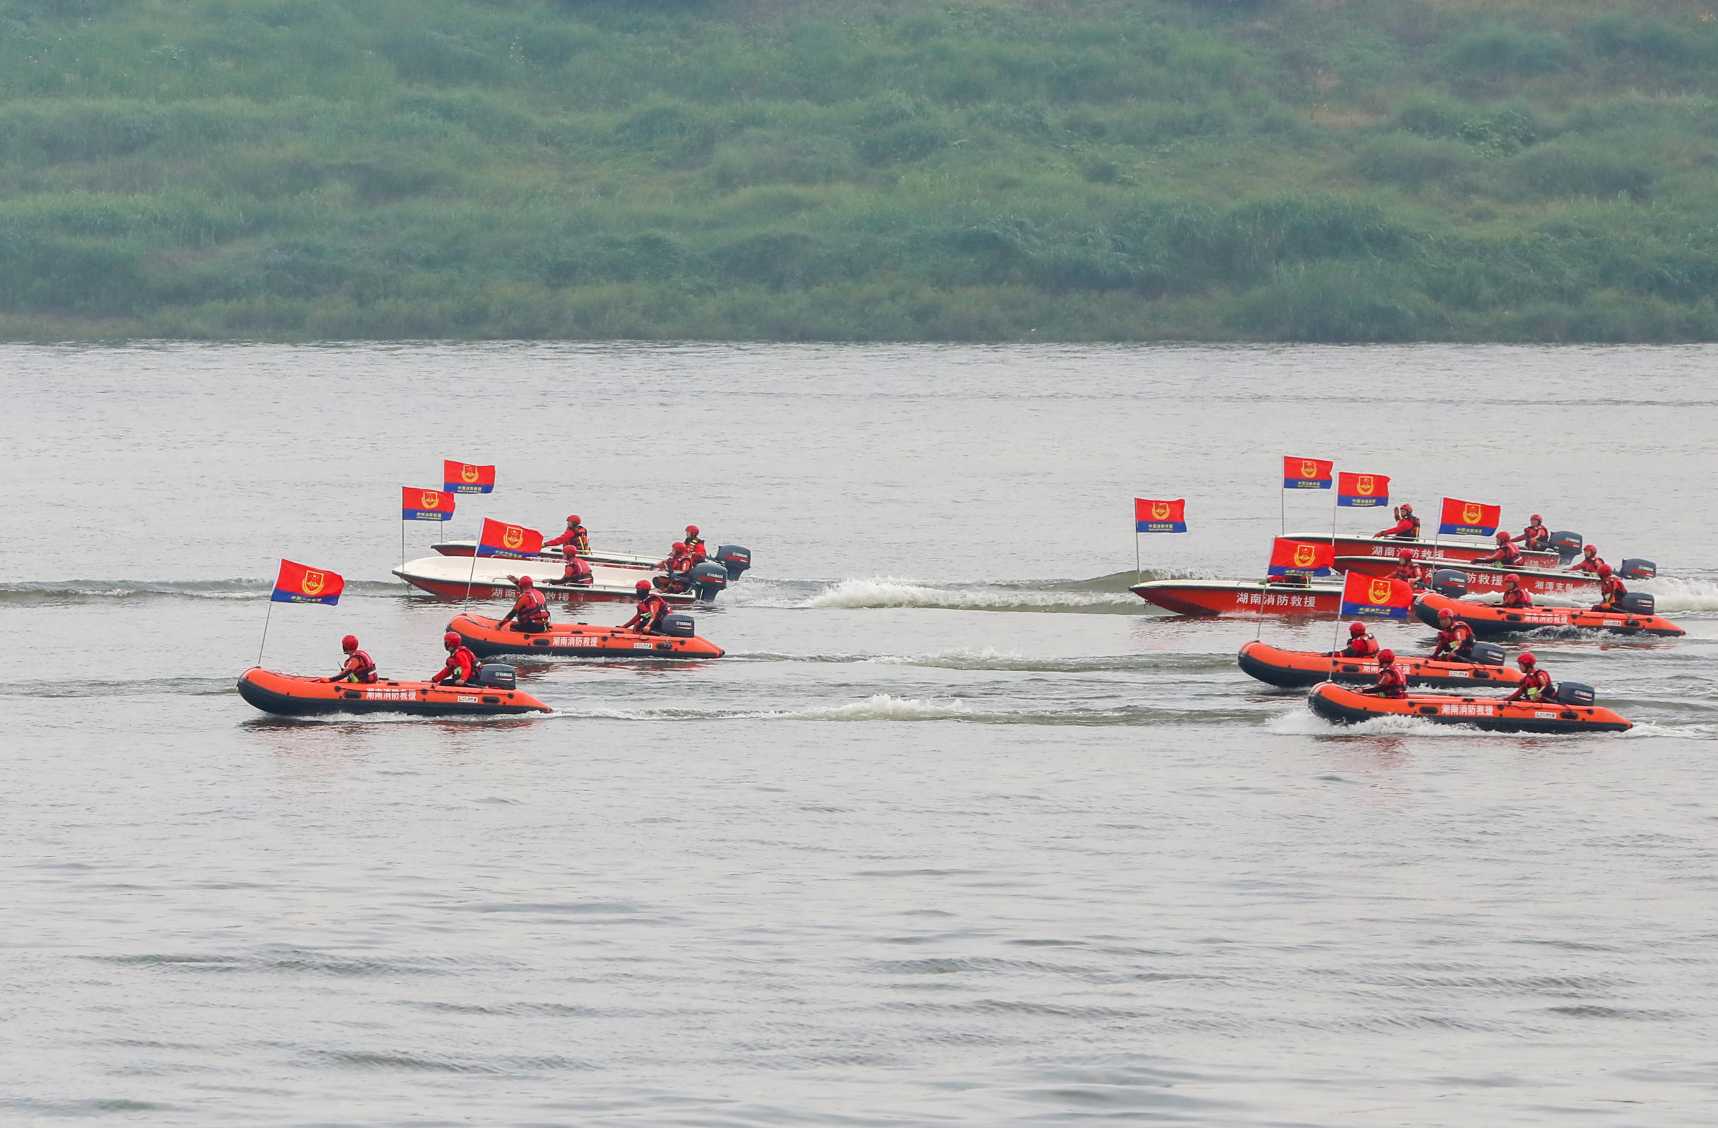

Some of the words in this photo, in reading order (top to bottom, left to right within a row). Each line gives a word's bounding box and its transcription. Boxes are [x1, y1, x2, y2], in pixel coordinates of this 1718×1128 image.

[1236, 592, 1317, 608] 湖南消防救援
[552, 636, 598, 648] 湖南消防救援
[366, 687, 417, 702] 湖南消防救援
[1441, 704, 1493, 718] 湖南消防救援
